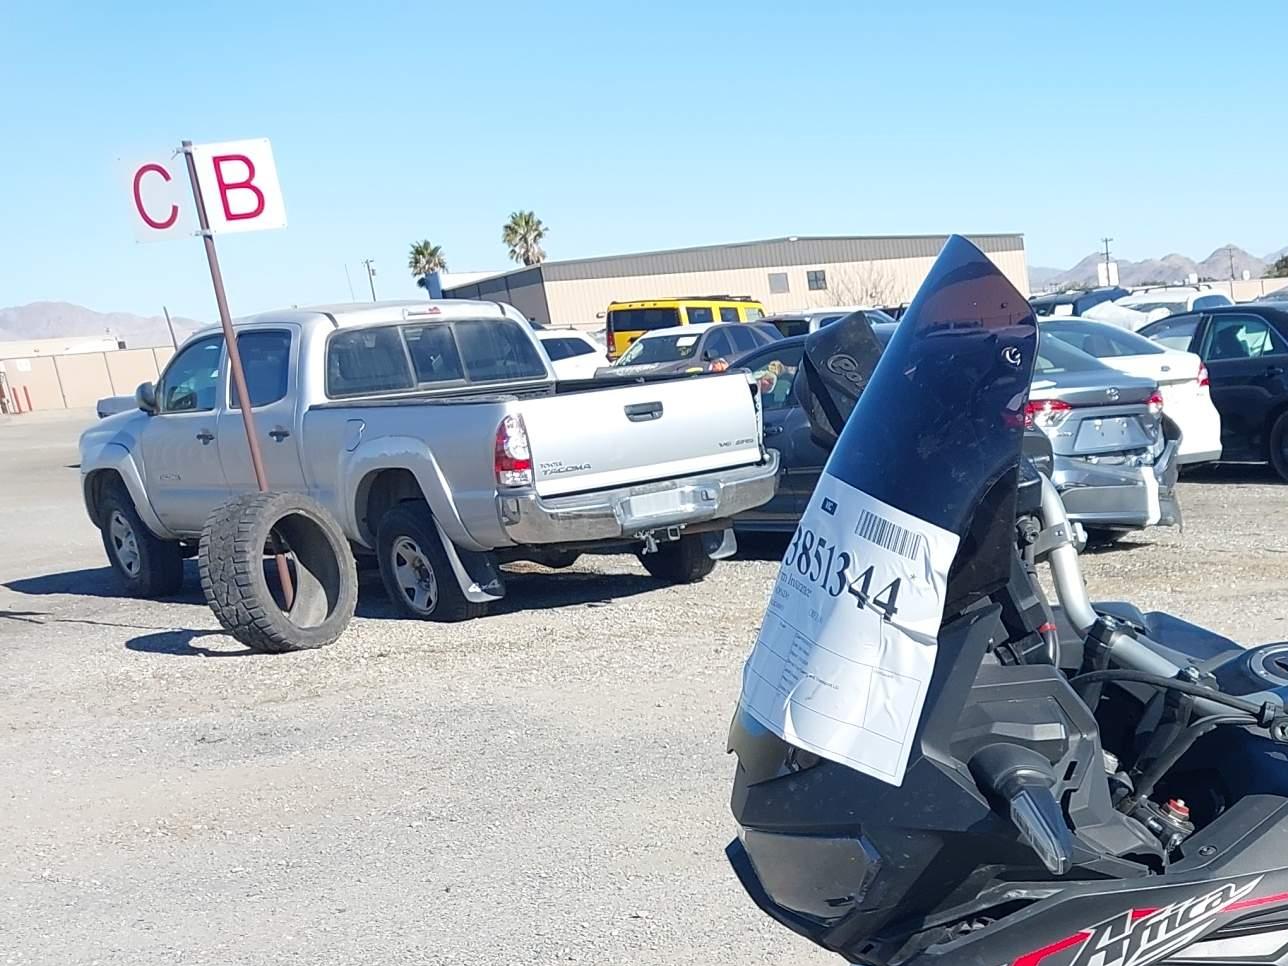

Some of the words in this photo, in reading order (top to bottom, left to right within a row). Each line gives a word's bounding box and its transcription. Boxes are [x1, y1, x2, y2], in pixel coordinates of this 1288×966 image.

[133, 163, 179, 230] C
[212, 154, 266, 221] B
[542, 463, 592, 476] TACOMA
